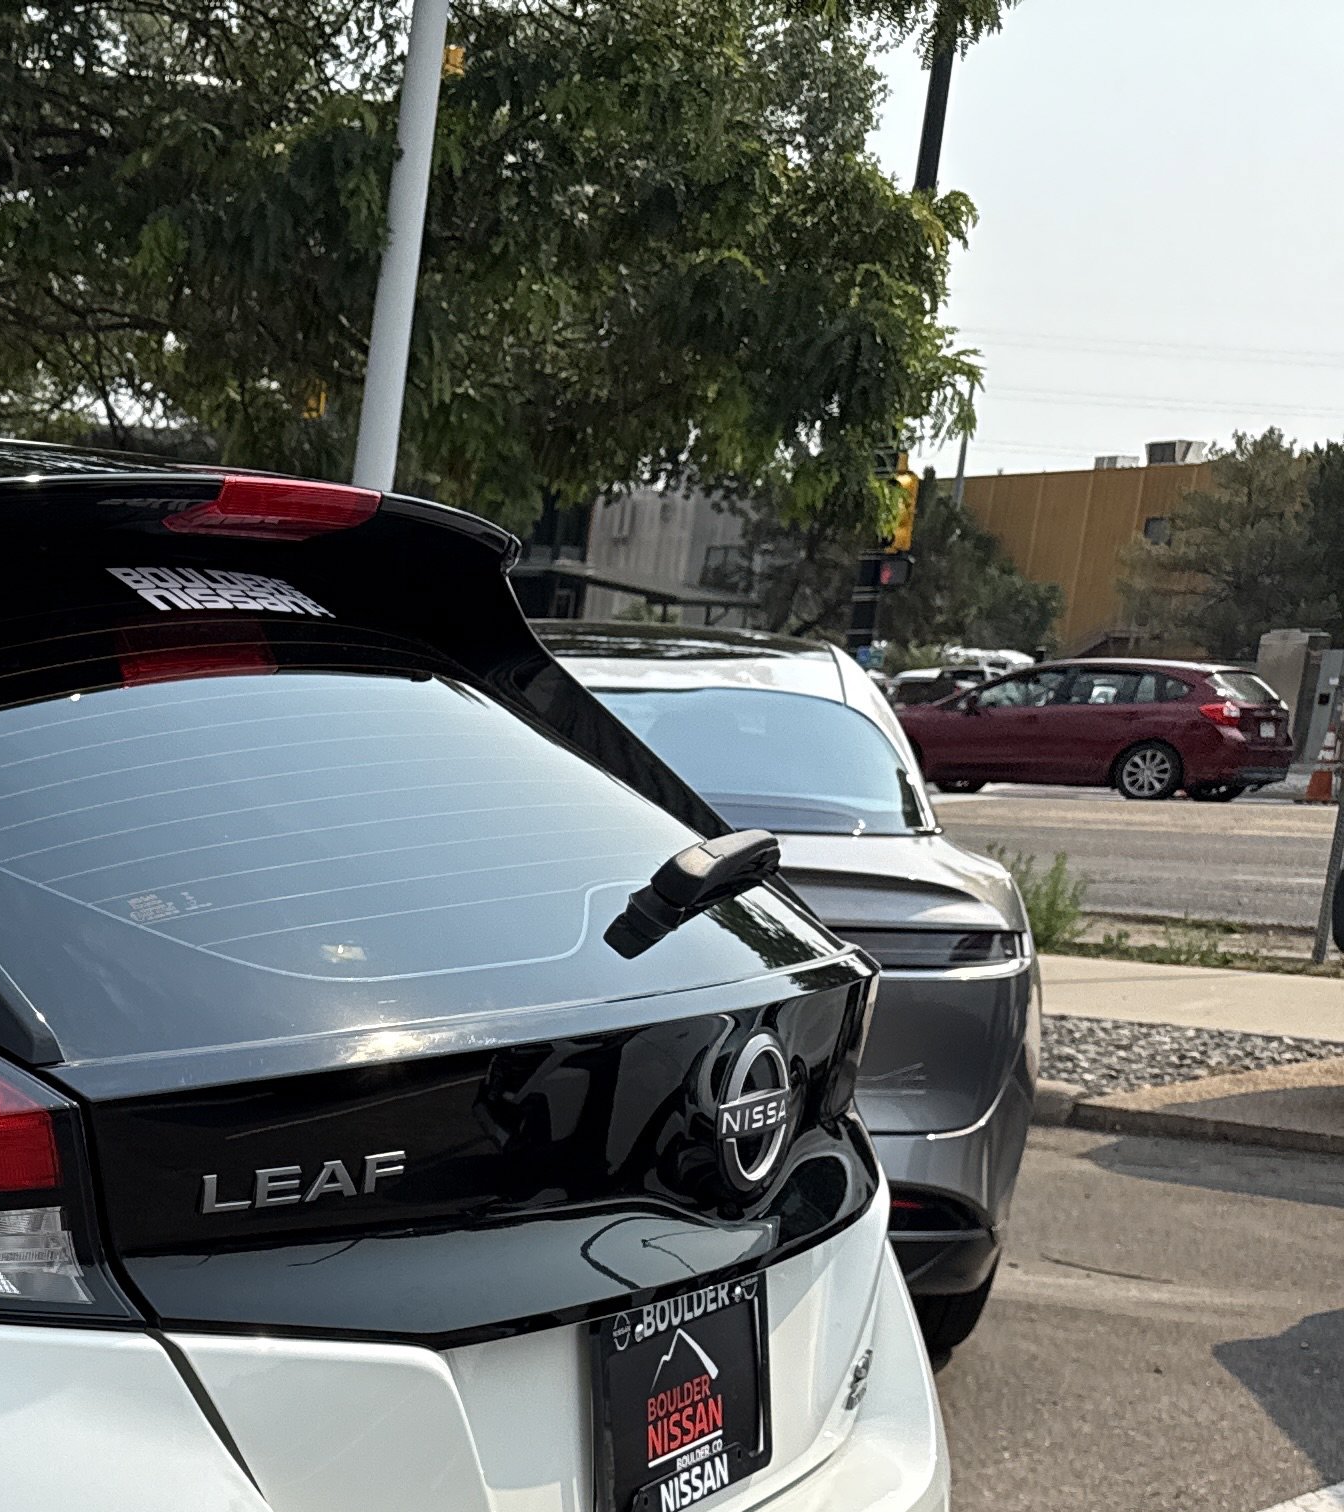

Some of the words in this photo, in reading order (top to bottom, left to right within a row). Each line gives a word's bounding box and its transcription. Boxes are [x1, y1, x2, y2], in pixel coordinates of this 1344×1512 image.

[105, 567, 289, 595] BOULDER
[721, 1098, 787, 1135] NISSA
[202, 1150, 407, 1214] LEAF
[643, 1281, 730, 1338] BOULDER
[647, 1373, 711, 1422] BOULDER
[647, 1393, 723, 1460] NISSAN
